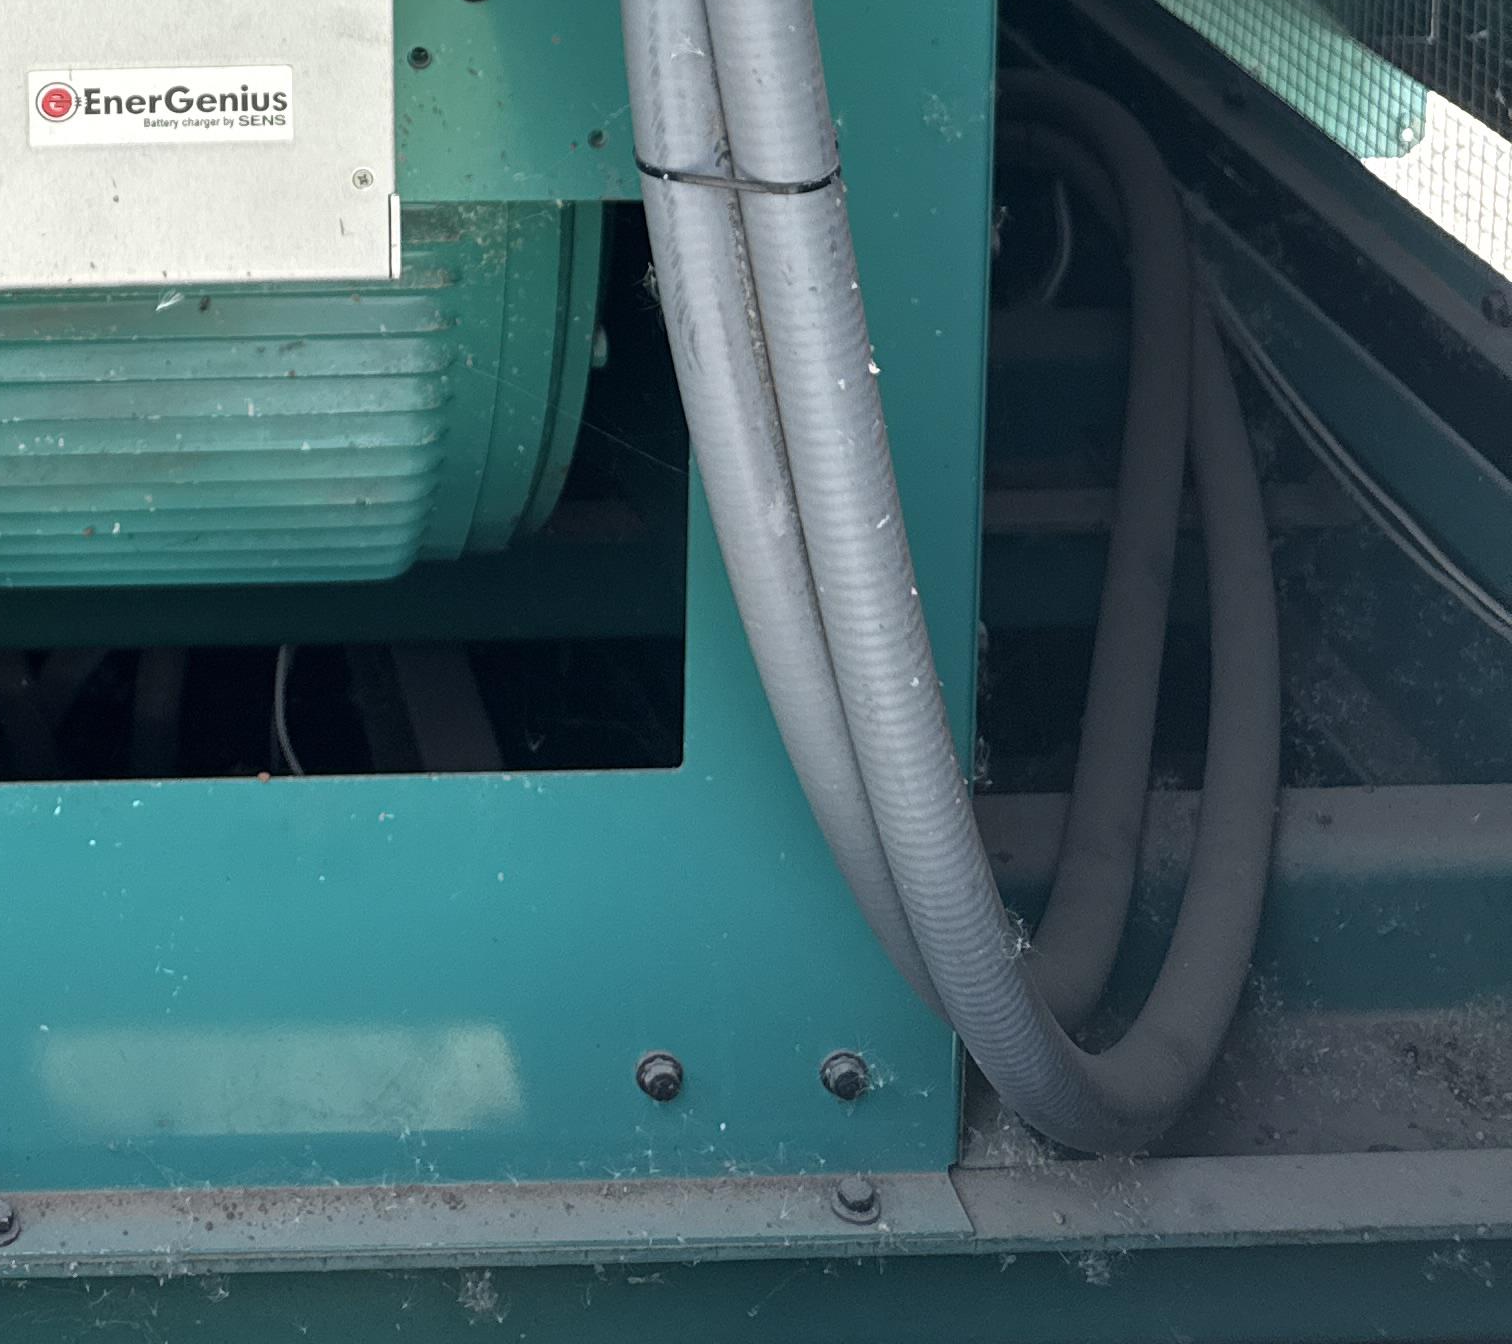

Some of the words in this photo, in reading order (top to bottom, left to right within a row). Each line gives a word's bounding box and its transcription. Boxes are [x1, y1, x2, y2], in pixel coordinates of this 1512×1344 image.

[84, 84, 288, 115] EnerGenius
[143, 117, 179, 129] Battery
[182, 116, 220, 128] charger
[223, 116, 235, 128] by
[238, 115, 286, 127] SENS
